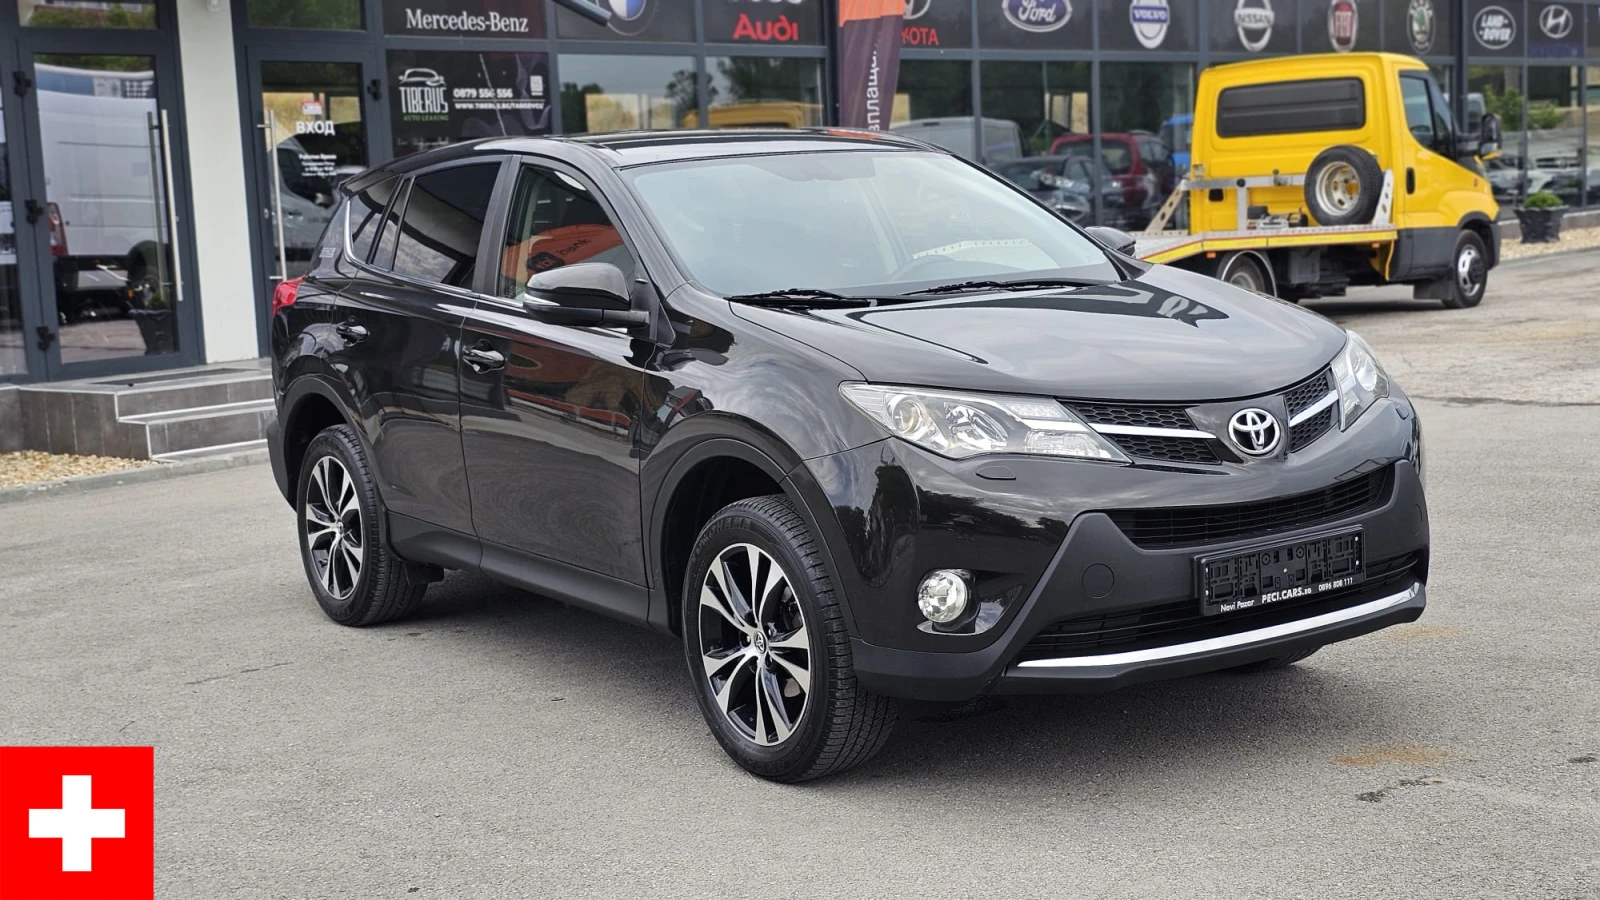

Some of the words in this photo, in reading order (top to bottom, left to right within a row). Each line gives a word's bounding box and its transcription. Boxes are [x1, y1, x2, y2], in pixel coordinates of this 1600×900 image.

[404, 8, 530, 33] Mercedes-Benz
[1018, 0, 1057, 22] Ford
[1133, 9, 1167, 20] VOLVO
[1236, 13, 1273, 26] NISSAN
[732, 12, 799, 41] Audi
[901, 27, 939, 45] YOTA
[398, 86, 449, 113] TIBERUS
[453, 88, 477, 98] 0879
[496, 88, 513, 98] 556
[295, 121, 336, 136] ВХОД
[1220, 601, 1236, 613] Novi
[1236, 599, 1255, 609] Pazar
[1344, 577, 1353, 586] 111
